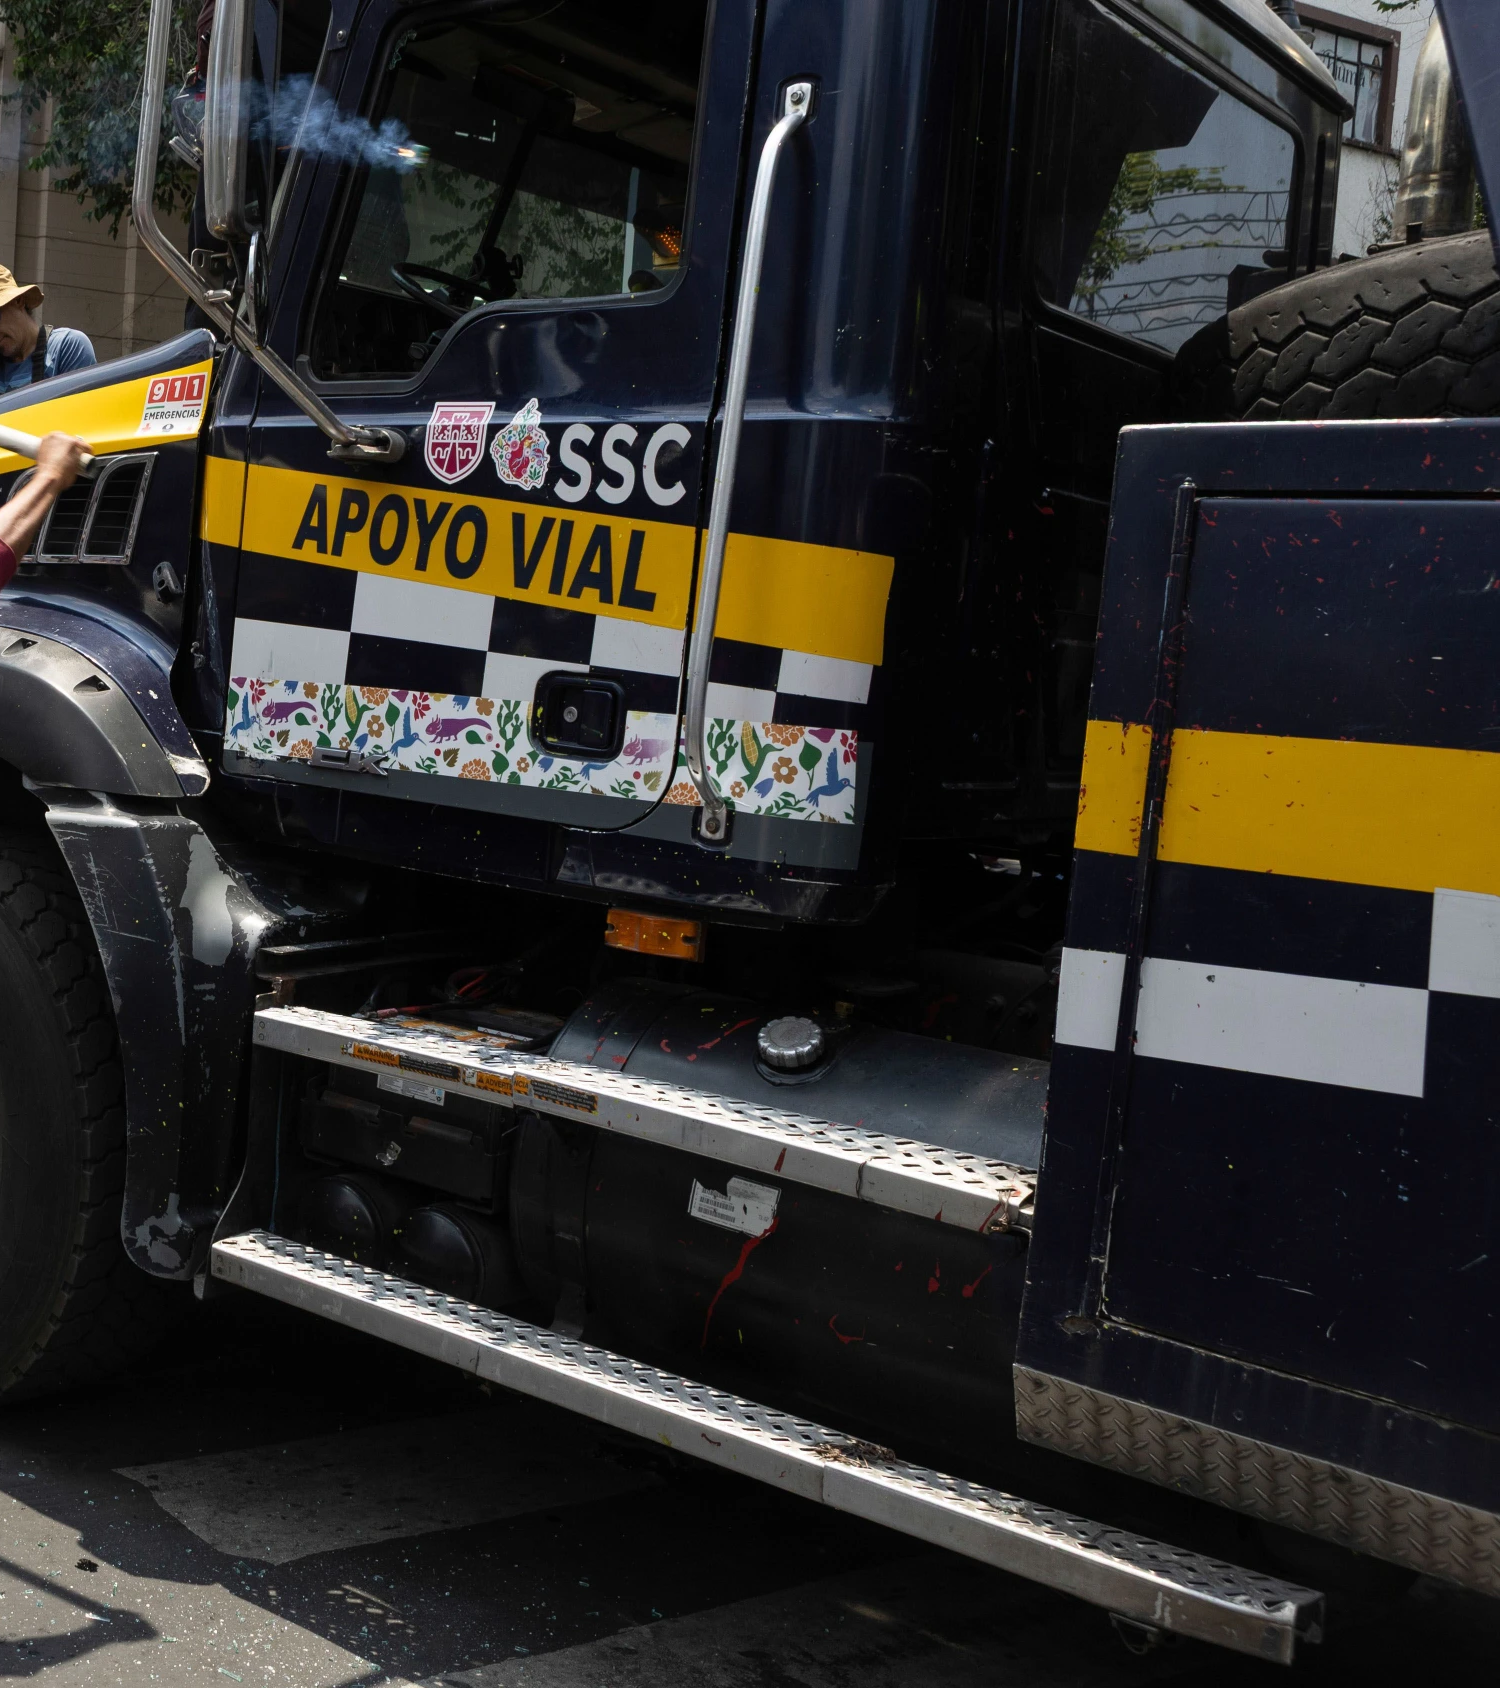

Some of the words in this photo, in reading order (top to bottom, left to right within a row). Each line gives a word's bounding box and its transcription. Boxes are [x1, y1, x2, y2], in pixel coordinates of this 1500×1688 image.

[152, 378, 200, 401] 911
[143, 408, 201, 421] EMERGENCIAS
[553, 422, 692, 506] SSC
[291, 484, 488, 580] APOYO
[511, 512, 657, 612] VIAL
[363, 1048, 396, 1062] WARNING
